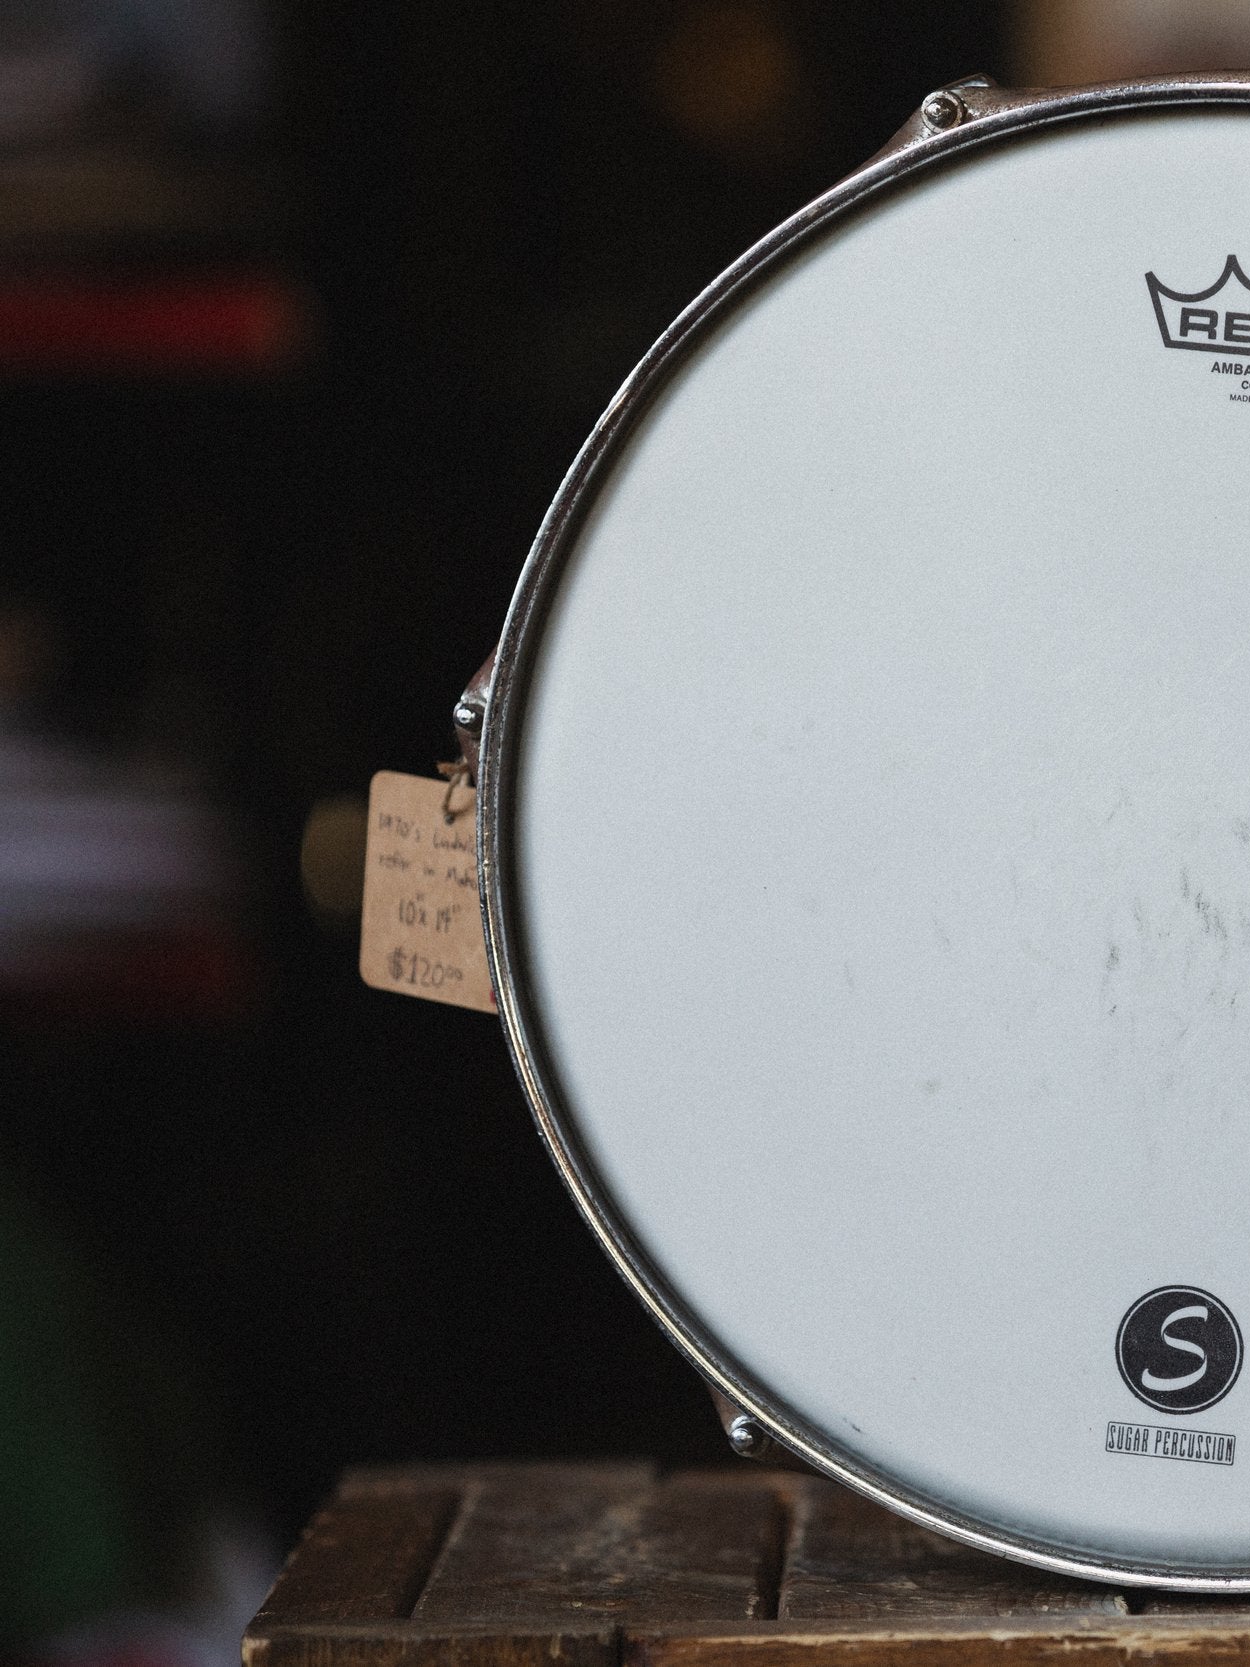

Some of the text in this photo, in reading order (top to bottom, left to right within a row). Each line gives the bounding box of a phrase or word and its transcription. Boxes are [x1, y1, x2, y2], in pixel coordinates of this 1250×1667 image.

[1141, 1305, 1209, 1392] S
[1108, 1424, 1234, 1462] SUGAR PERCUSSION
